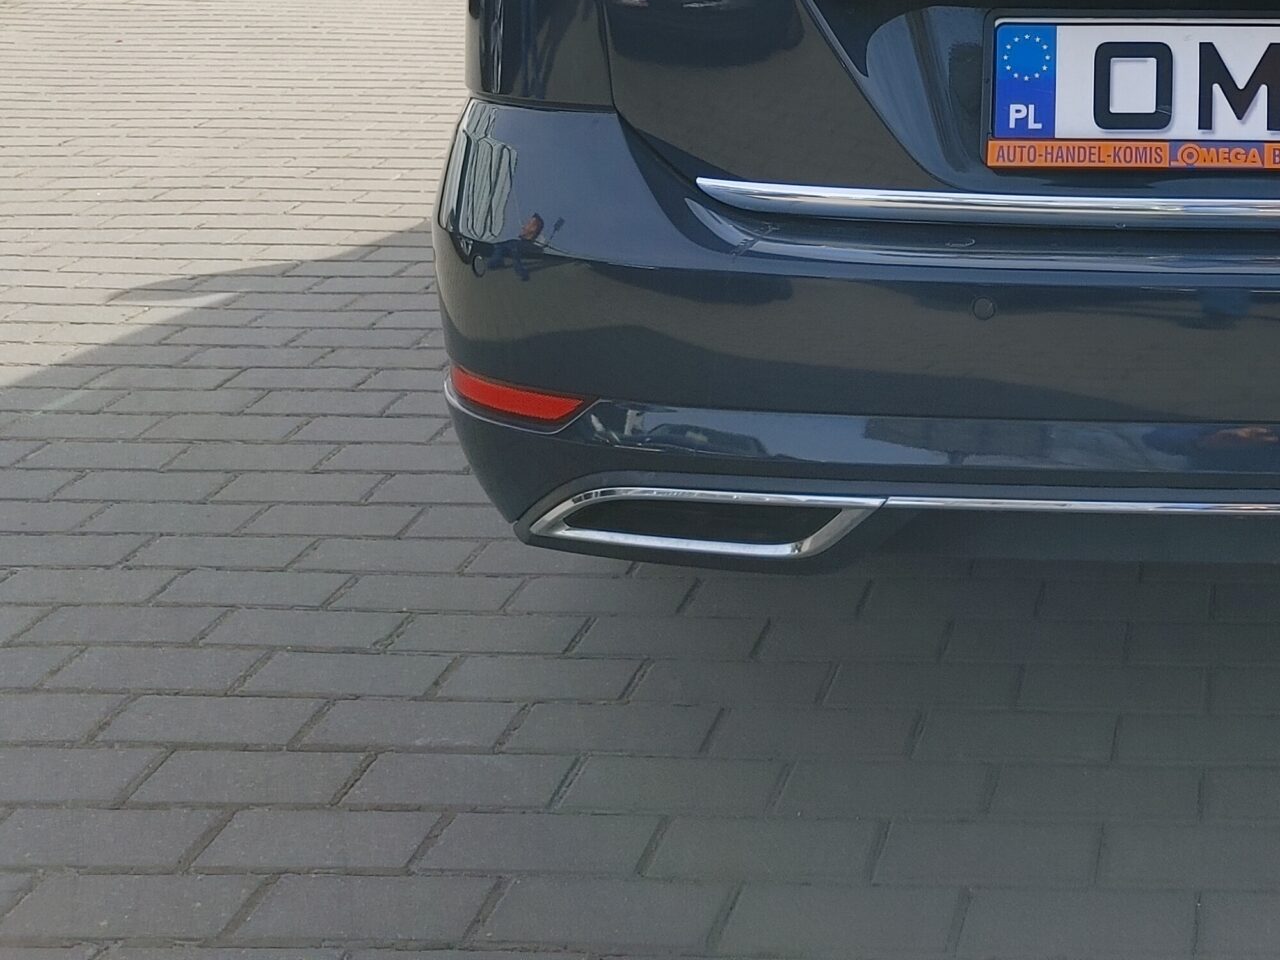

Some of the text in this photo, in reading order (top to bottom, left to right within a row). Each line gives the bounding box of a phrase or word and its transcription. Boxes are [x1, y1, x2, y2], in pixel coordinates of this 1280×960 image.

[1009, 104, 1042, 129] PL
[996, 144, 1163, 165] AUTO-HANDEL-KOMIS
[1177, 143, 1265, 167] OMEGA
